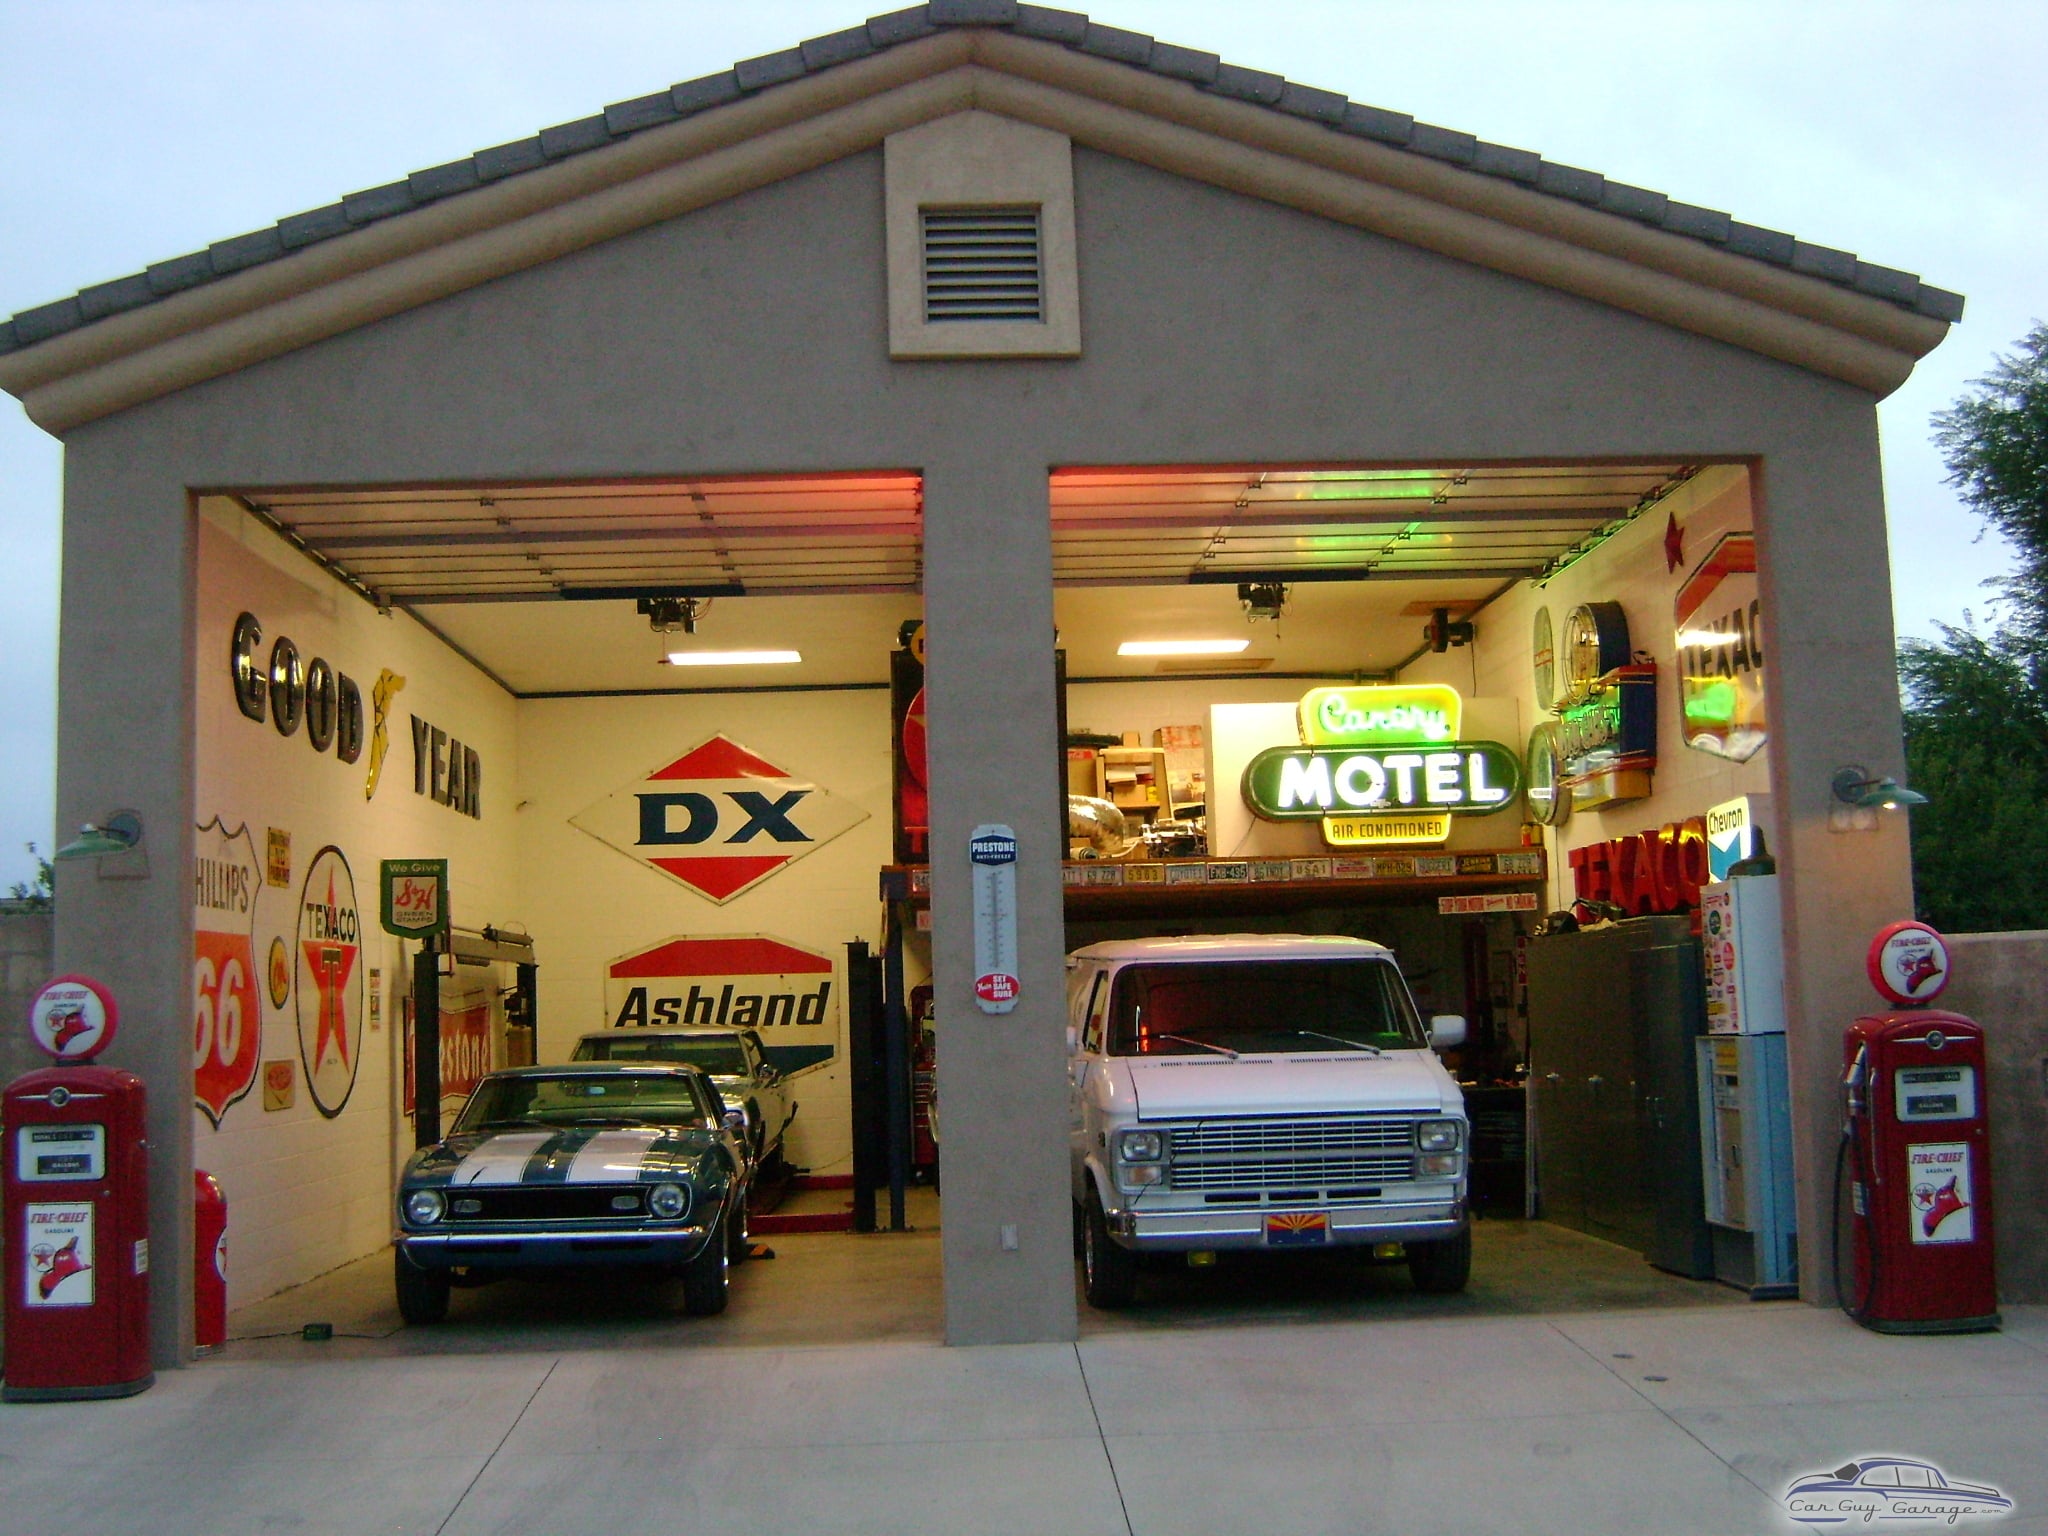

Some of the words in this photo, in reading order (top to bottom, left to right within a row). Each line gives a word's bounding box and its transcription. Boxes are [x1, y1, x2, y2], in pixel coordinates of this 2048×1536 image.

[1686, 600, 1762, 682] TEXAC
[231, 611, 364, 765] GOOD
[410, 713, 481, 820] YEAR
[1319, 694, 1451, 740] Canary
[1277, 752, 1505, 809] MOTEL
[633, 790, 815, 846] DX
[1332, 824, 1354, 839] AIR
[1359, 821, 1442, 838] CONDITIONED
[1708, 806, 1743, 836] Chevron
[389, 863, 408, 873] We
[411, 863, 440, 873] Give
[972, 841, 1015, 853] PRESTONE
[1568, 816, 1709, 924] TEXACO
[195, 857, 249, 914] HILLIPS
[306, 902, 356, 943] TEXACO
[194, 956, 245, 1070] 66
[615, 981, 831, 1028] Ashland
[1911, 1151, 1965, 1165] FIRE-CHIEF
[31, 1212, 88, 1223] FIRE-CHIEF
